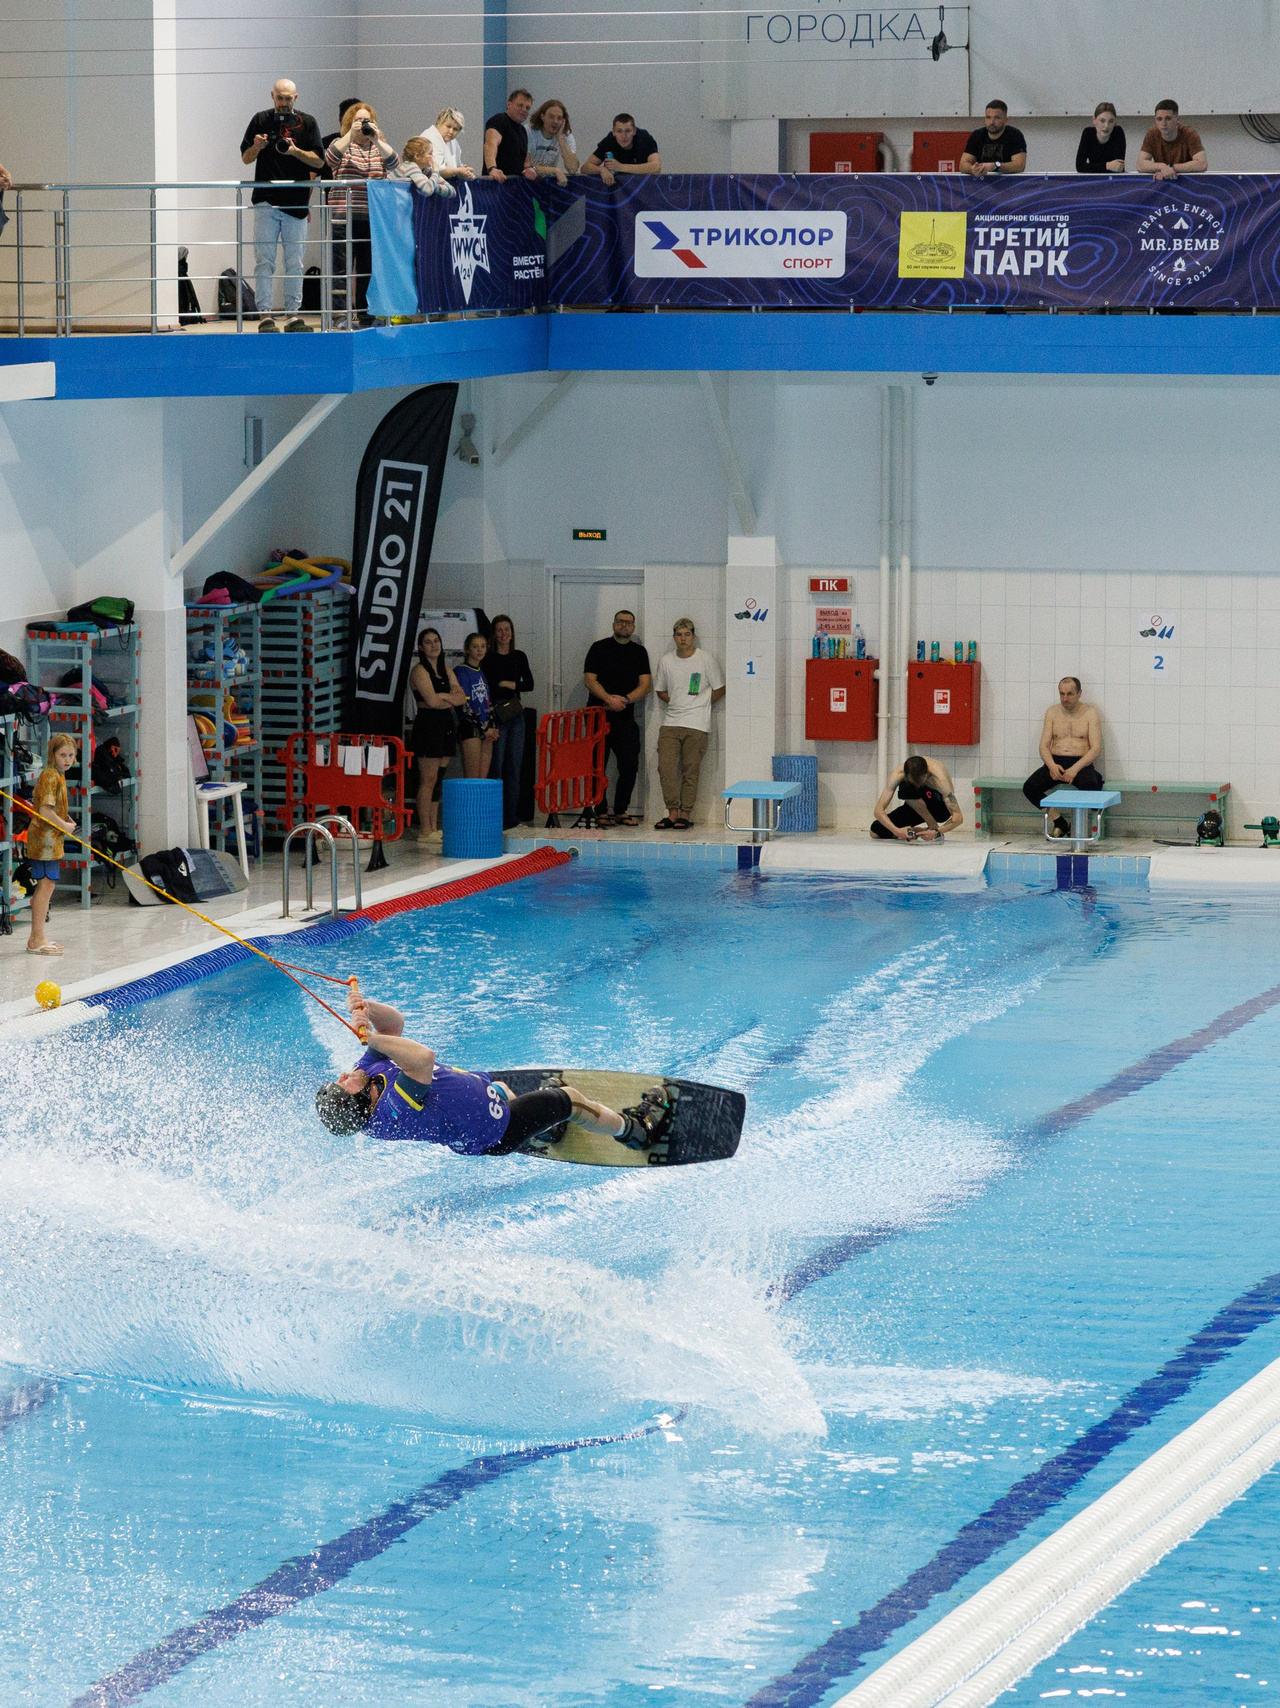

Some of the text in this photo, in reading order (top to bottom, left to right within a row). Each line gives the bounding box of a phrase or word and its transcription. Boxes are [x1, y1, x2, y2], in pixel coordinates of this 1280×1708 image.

[746, 12, 927, 49] ГОРОДКА
[974, 214, 1070, 222] АКЦИОНЕРНОЕ ОБЩЕСТВО
[1137, 203, 1225, 235] TRAVEL ENERGY
[689, 227, 834, 246] ТРИКОЛОР
[974, 222, 1069, 247] ТРЕТИЙ
[1140, 238, 1220, 251] MR.BEMB
[782, 258, 834, 269] СПОРТ
[973, 249, 1069, 276] ПАРК
[1148, 265, 1213, 286] SINCE 2022
[578, 531, 602, 539] ВЫХОД
[359, 480, 414, 680] STUDIO 21
[819, 579, 839, 591] ПК
[746, 660, 756, 675] 1
[1153, 655, 1164, 670] 2
